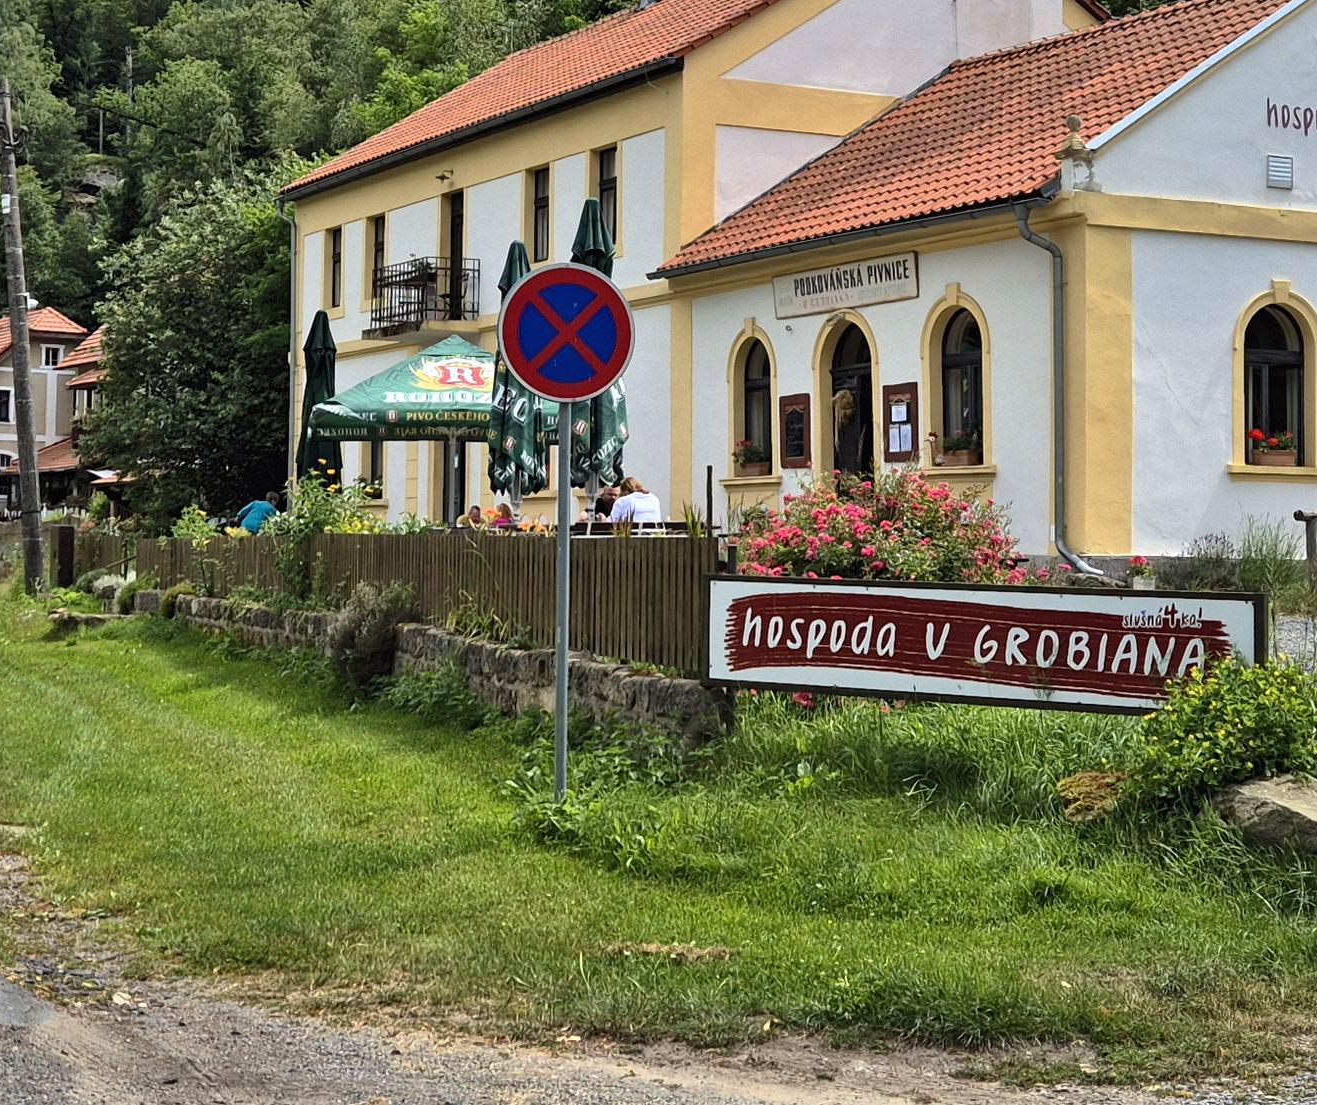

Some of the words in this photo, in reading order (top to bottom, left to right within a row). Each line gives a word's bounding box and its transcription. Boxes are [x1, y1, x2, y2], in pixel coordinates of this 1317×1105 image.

[793, 263, 864, 298] PODKOVÁŇSKÁ
[867, 258, 910, 285] PIVNICE
[384, 391, 493, 403] ROHOZ
[406, 411, 433, 421] PIVO
[435, 409, 490, 422] ČESKÉHO
[742, 607, 897, 659] hospoda
[925, 622, 951, 660] V
[973, 624, 1205, 678] GROBIANA
